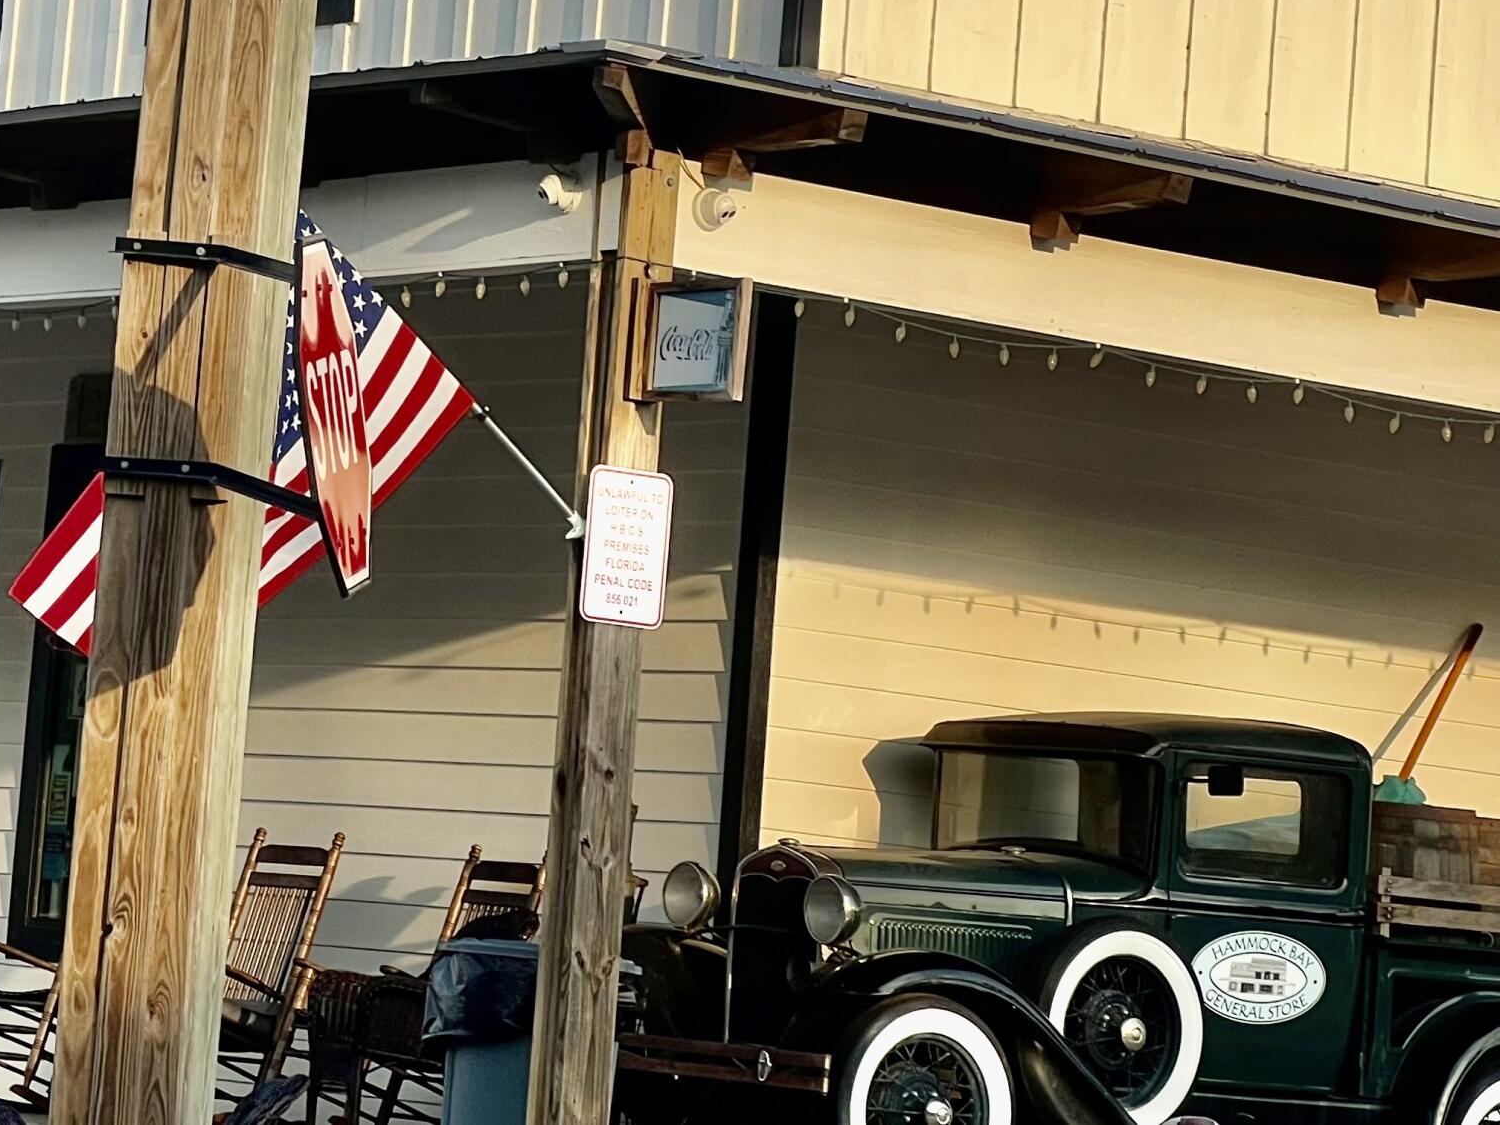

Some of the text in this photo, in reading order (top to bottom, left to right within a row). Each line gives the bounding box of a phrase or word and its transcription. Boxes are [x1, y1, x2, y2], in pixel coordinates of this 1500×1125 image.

[306, 350, 358, 482] STOP
[604, 539, 650, 555] PREMISES
[605, 557, 645, 572] FLORIDA
[594, 573, 653, 592] PENAL CODE
[1212, 937, 1315, 969] HAMMOCK BAY
[1205, 989, 1308, 1019] GENERAL STORE
